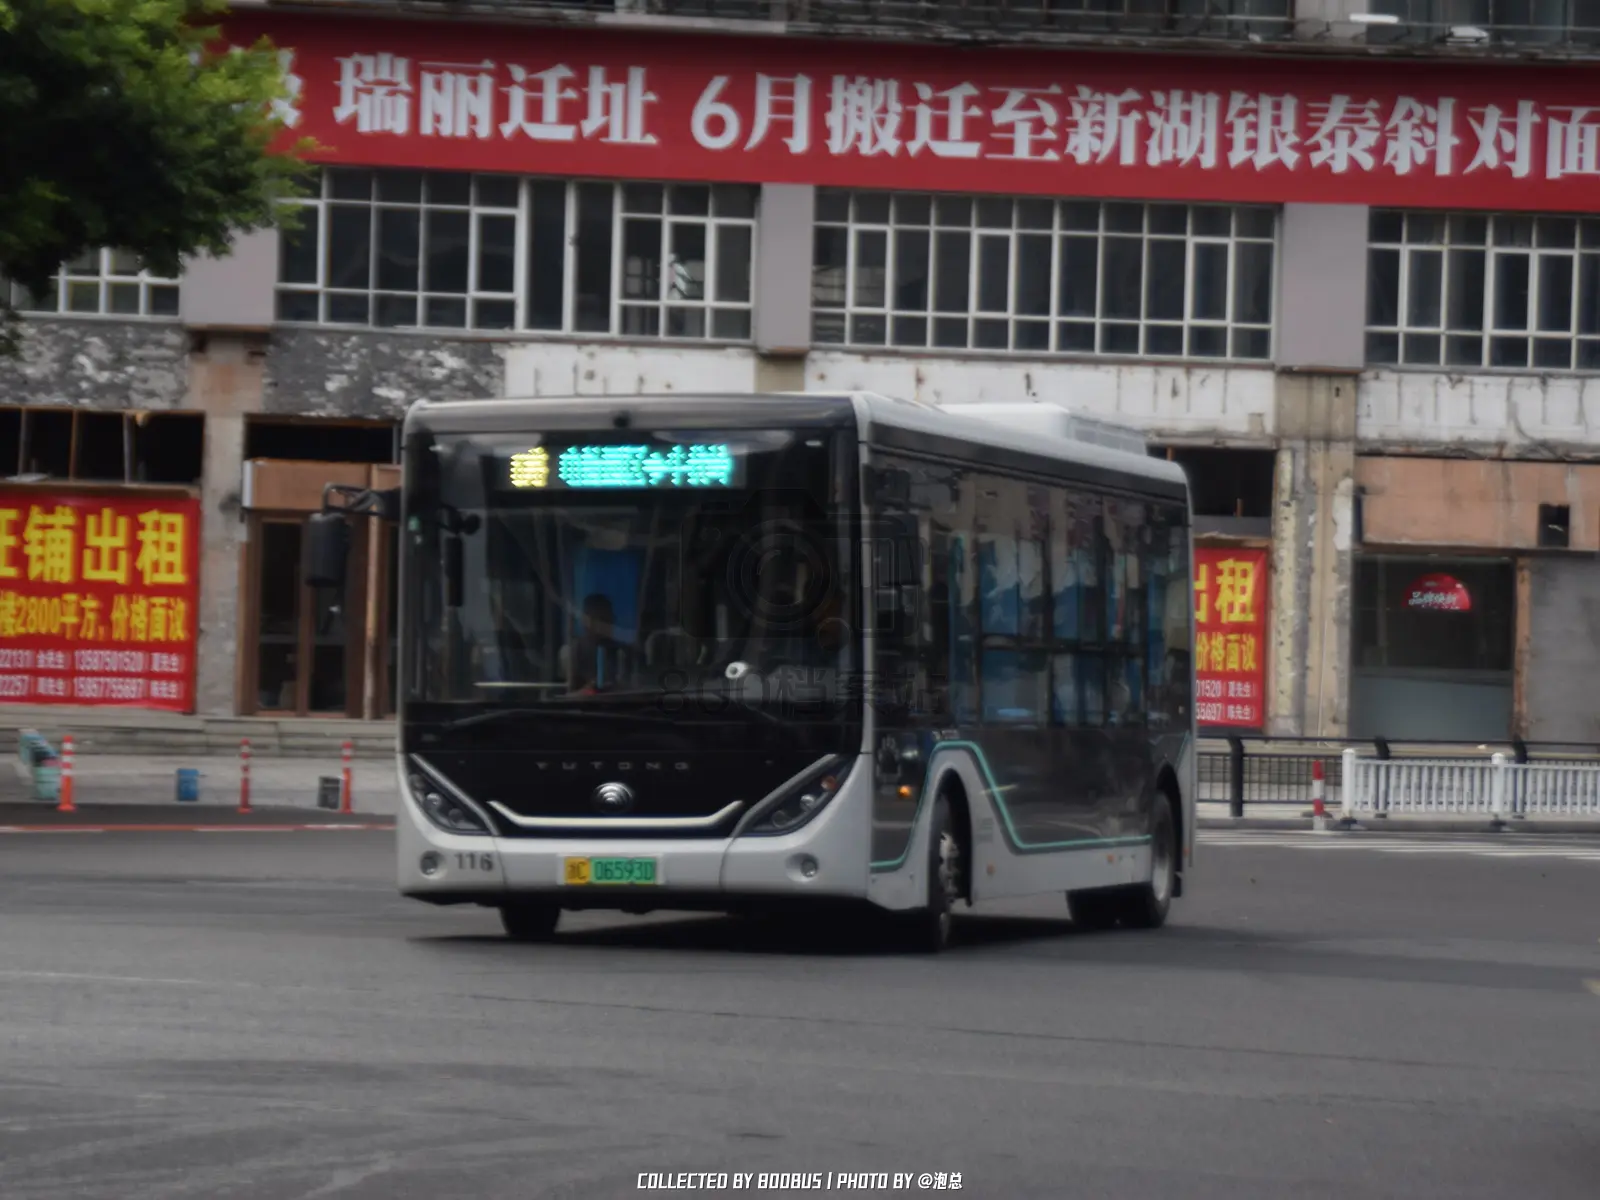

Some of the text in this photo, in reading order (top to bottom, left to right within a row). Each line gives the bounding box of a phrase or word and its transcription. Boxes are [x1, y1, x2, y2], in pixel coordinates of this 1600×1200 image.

[333, 52, 658, 146] 瑞丽迁址
[690, 72, 1600, 180] 6月搬迁至新湖银泰斜对面
[536, 760, 690, 771] YUTONG
[454, 852, 494, 872] 116
